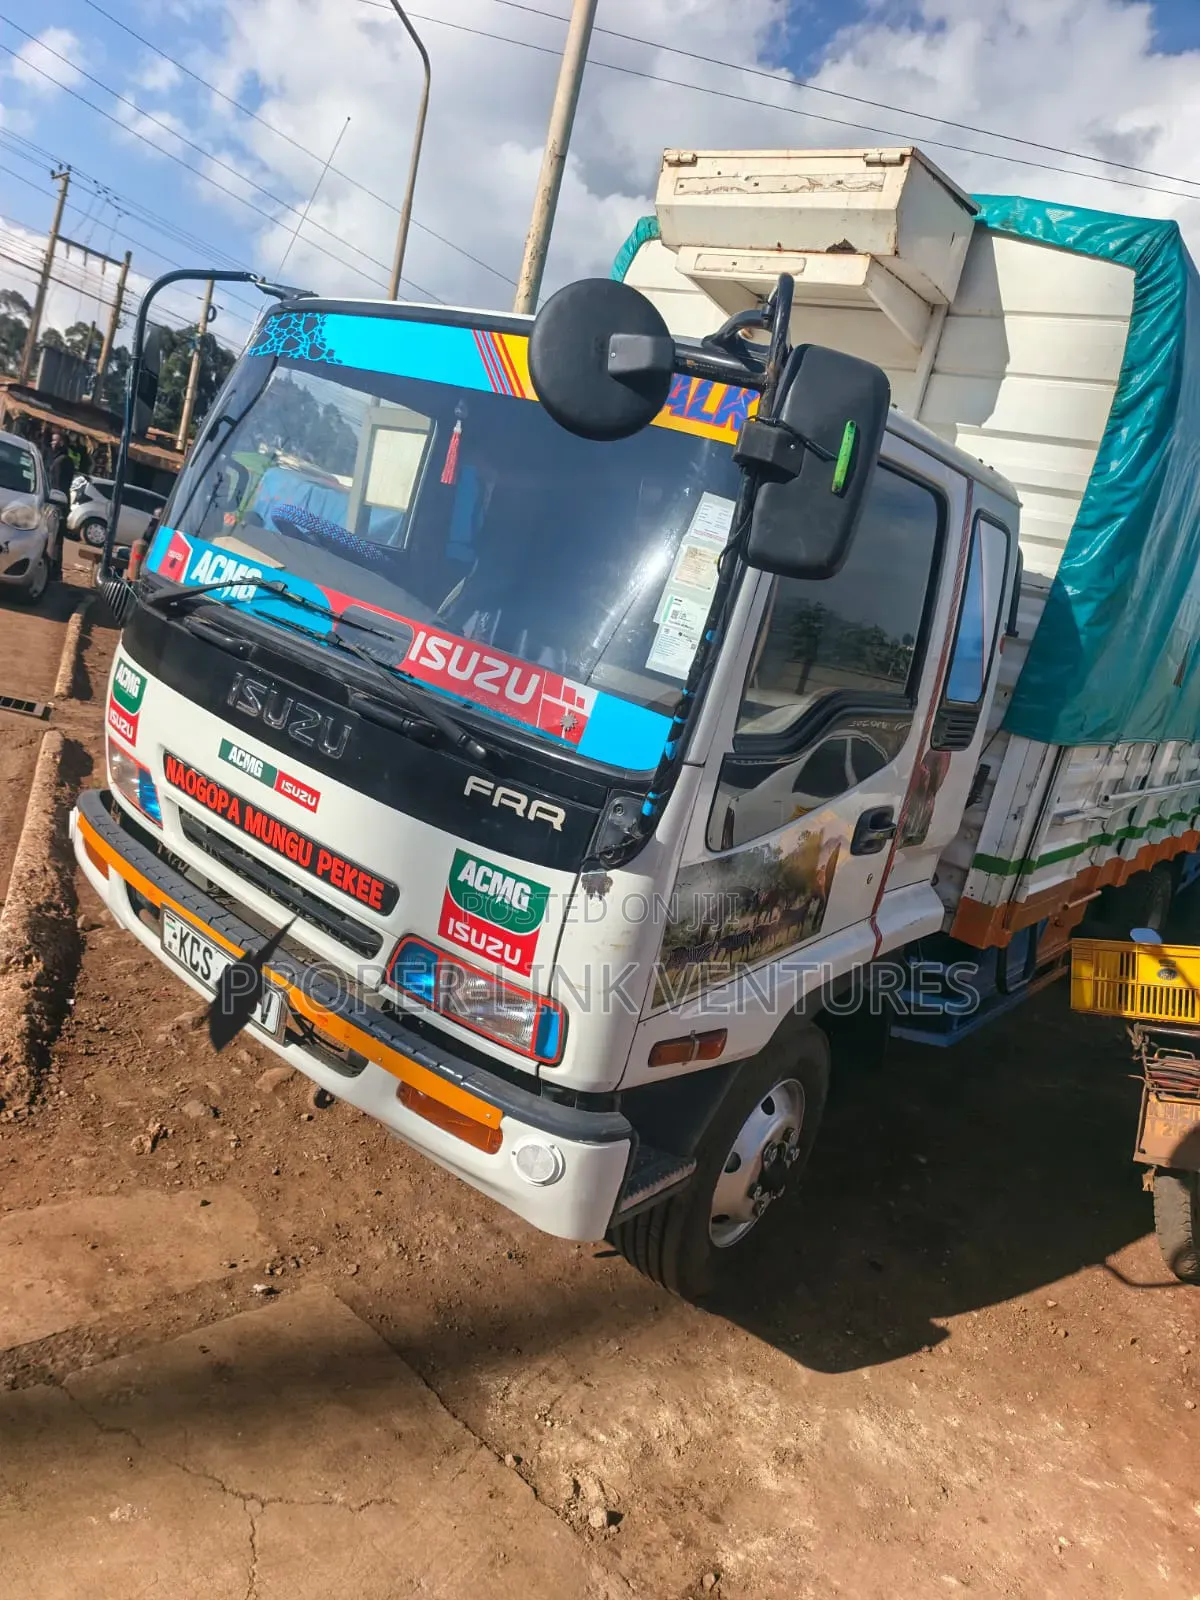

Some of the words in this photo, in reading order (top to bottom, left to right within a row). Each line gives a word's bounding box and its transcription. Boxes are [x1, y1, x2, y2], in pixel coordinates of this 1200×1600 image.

[190, 550, 262, 604] ACMG
[116, 663, 141, 699] ACMG
[408, 631, 541, 705] ISUZU
[109, 707, 134, 739] ISUZU
[227, 672, 352, 759] ISUZU
[228, 746, 264, 778] ACMG
[281, 779, 317, 806] ISUZU
[463, 775, 566, 832] FRR
[166, 755, 240, 826] NAOGOPA
[244, 805, 313, 867] MUNGU
[316, 849, 385, 910] PEKEE
[457, 859, 531, 912] ACMG
[179, 926, 213, 981] KCS
[447, 917, 522, 965] ISUZU
